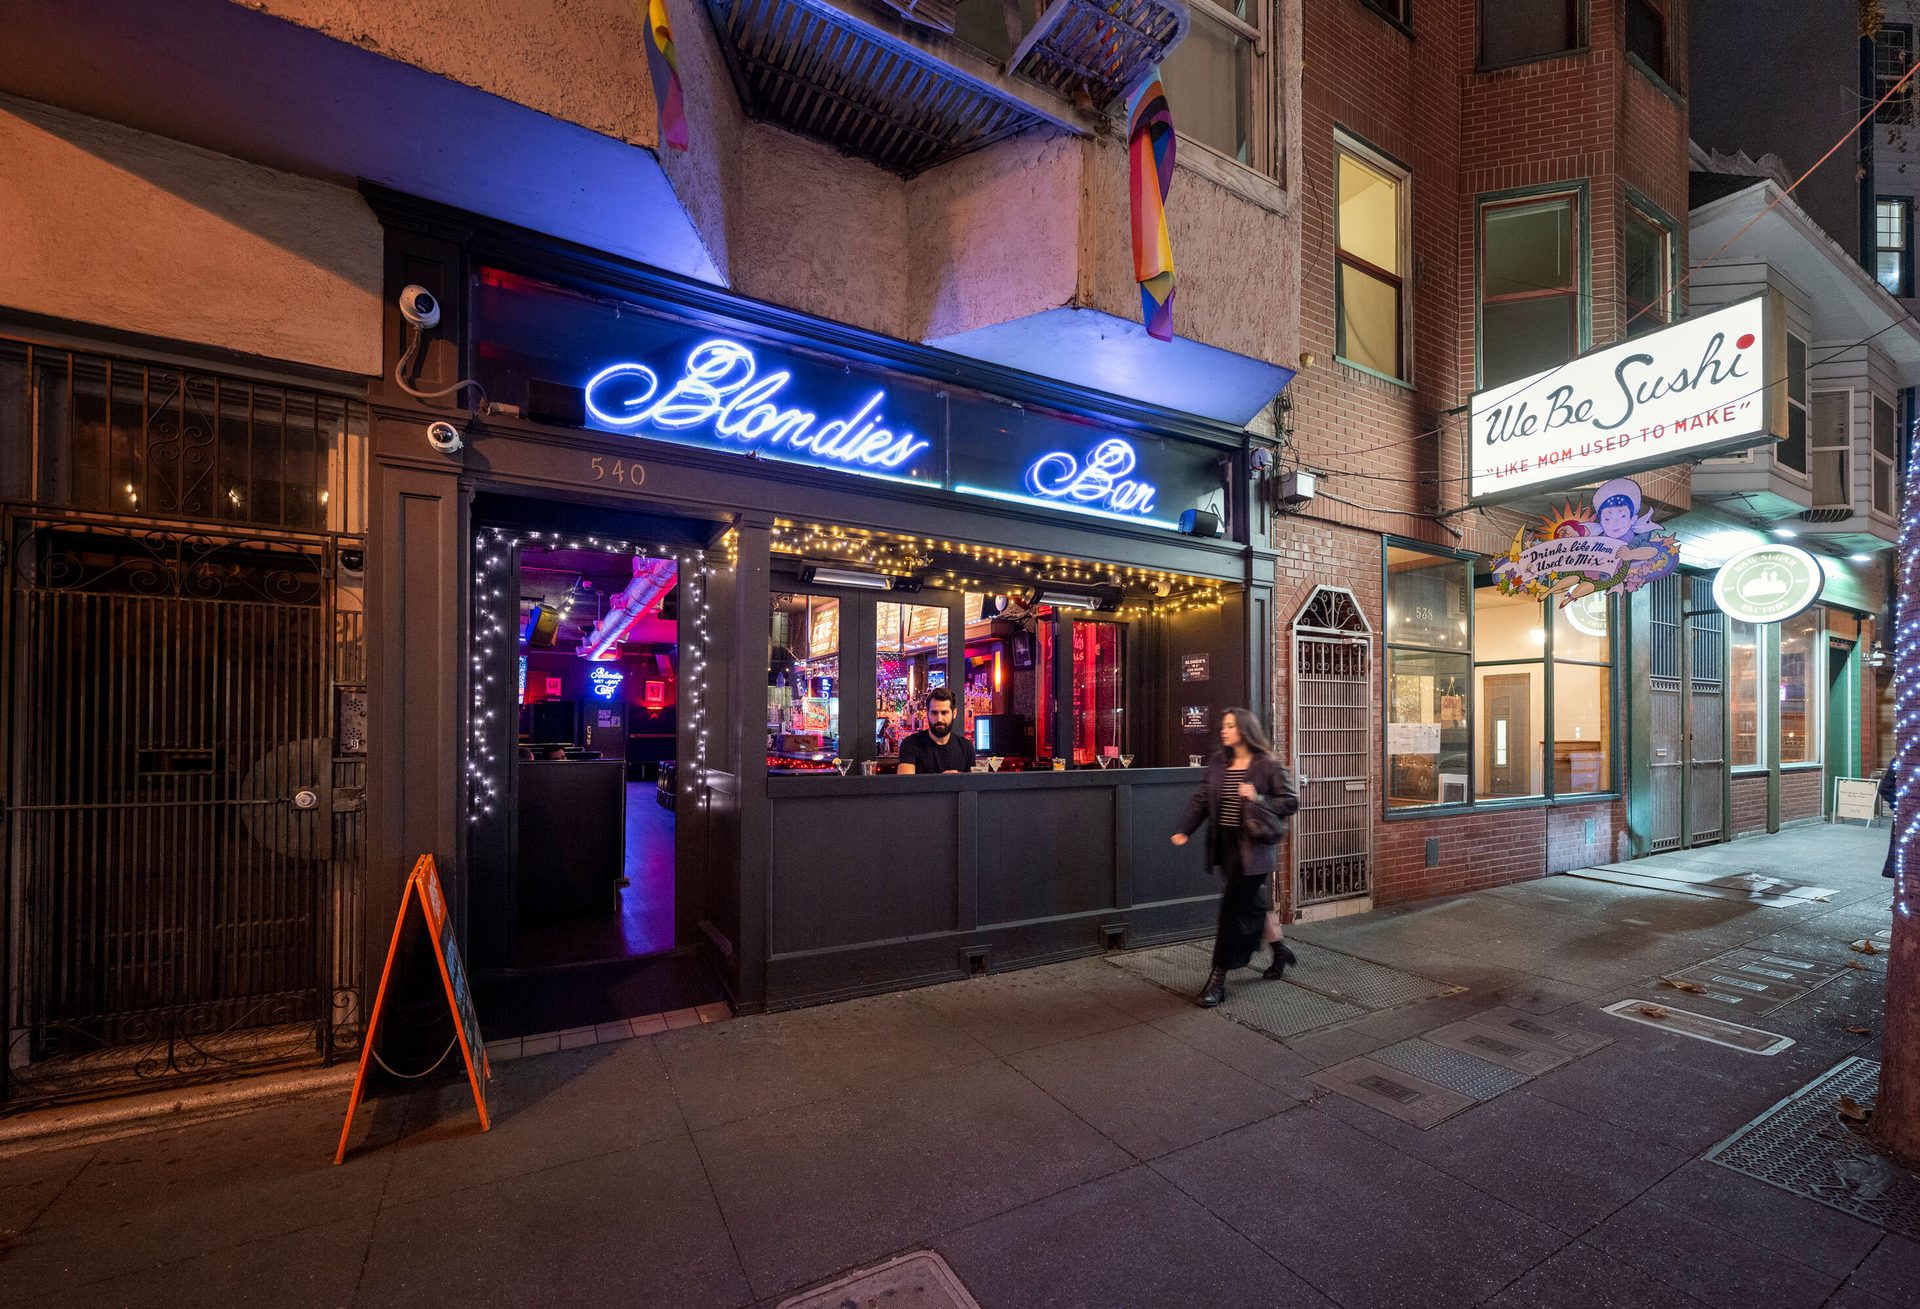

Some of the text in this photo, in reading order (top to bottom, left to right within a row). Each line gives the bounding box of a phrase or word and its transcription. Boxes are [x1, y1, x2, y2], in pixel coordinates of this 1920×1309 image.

[1486, 332, 1756, 446] We Be Sushi
[584, 340, 1156, 514] Blondies Bar
[1486, 401, 1751, 479] "LIKE MOM USED TO MAKE"
[591, 456, 646, 486] 540
[1569, 540, 1591, 553] like
[1591, 541, 1614, 554] Mom
[1536, 555, 1565, 572] Used
[1565, 554, 1574, 565] to
[1415, 606, 1433, 621] 538
